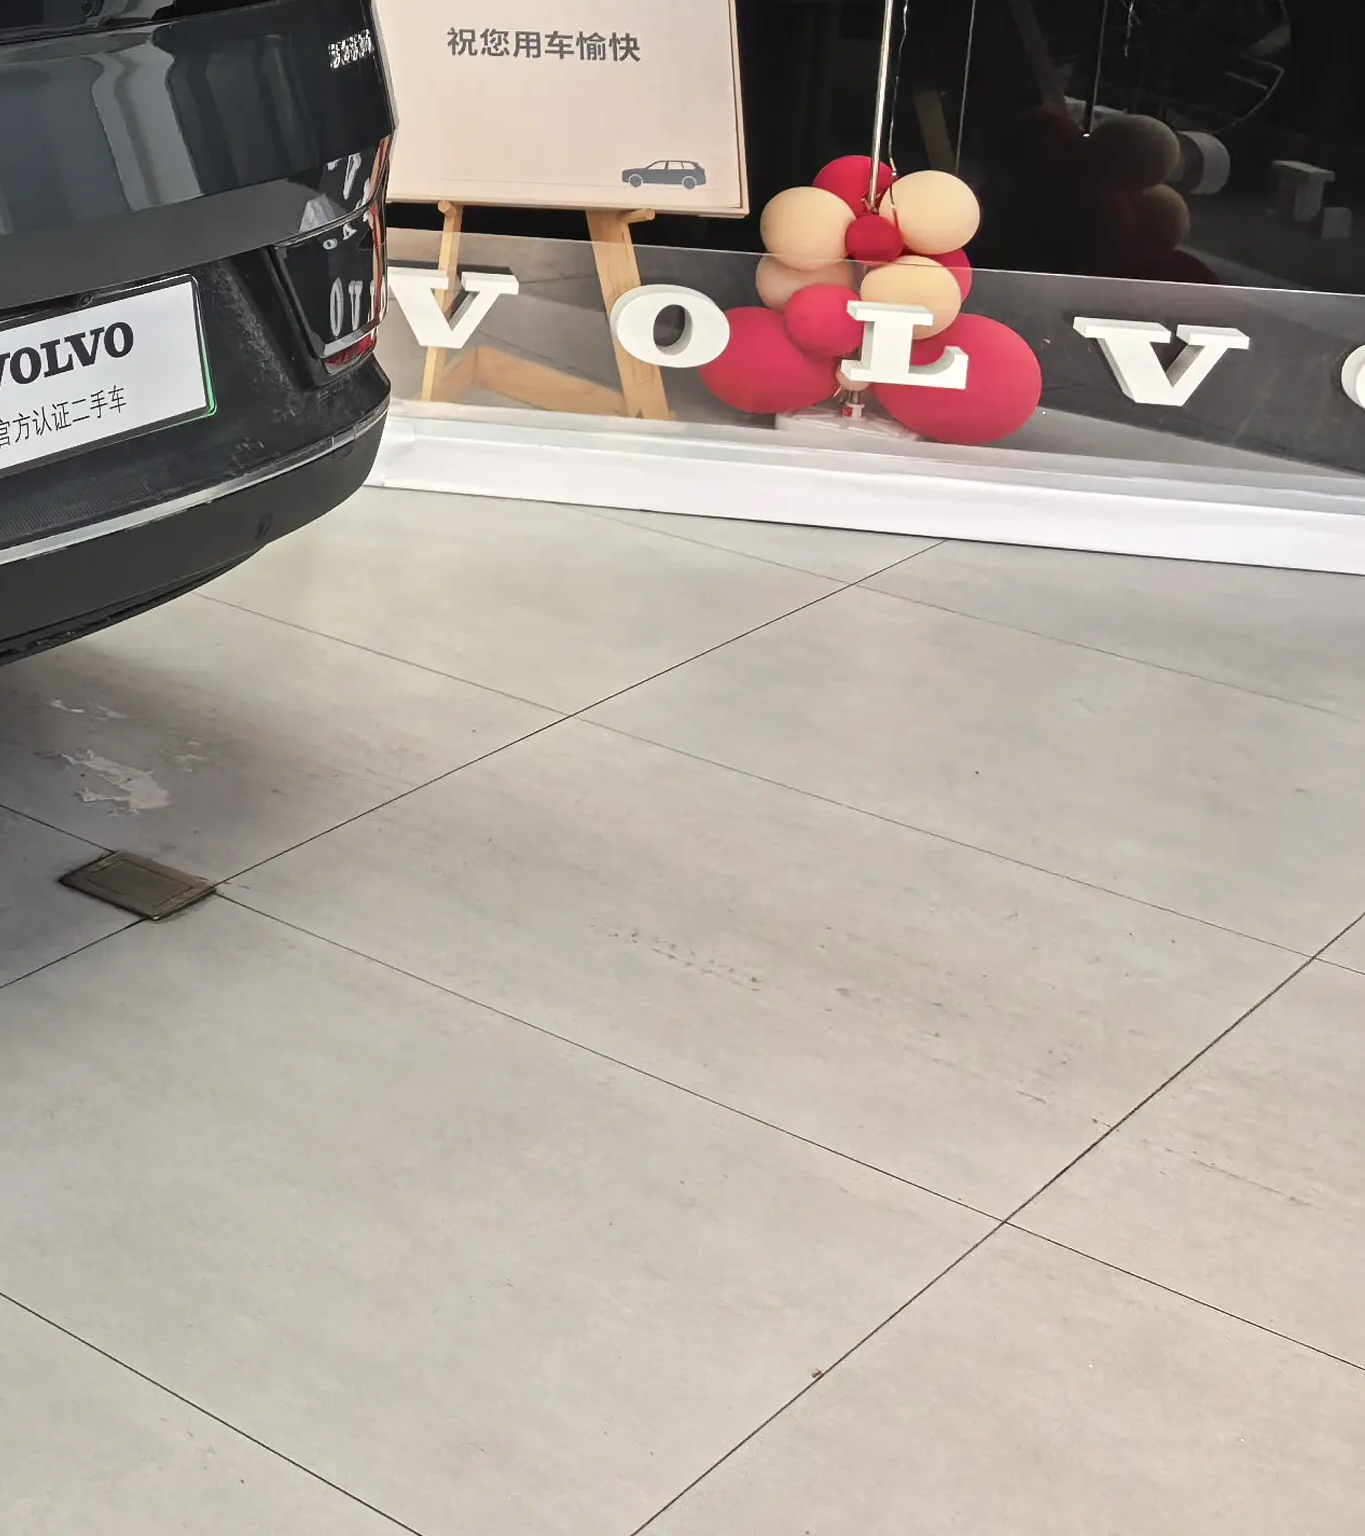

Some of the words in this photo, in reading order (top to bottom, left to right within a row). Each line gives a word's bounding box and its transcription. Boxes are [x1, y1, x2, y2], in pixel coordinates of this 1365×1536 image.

[447, 26, 641, 63] 祝您用车愉快
[387, 265, 1365, 411] VOLV
